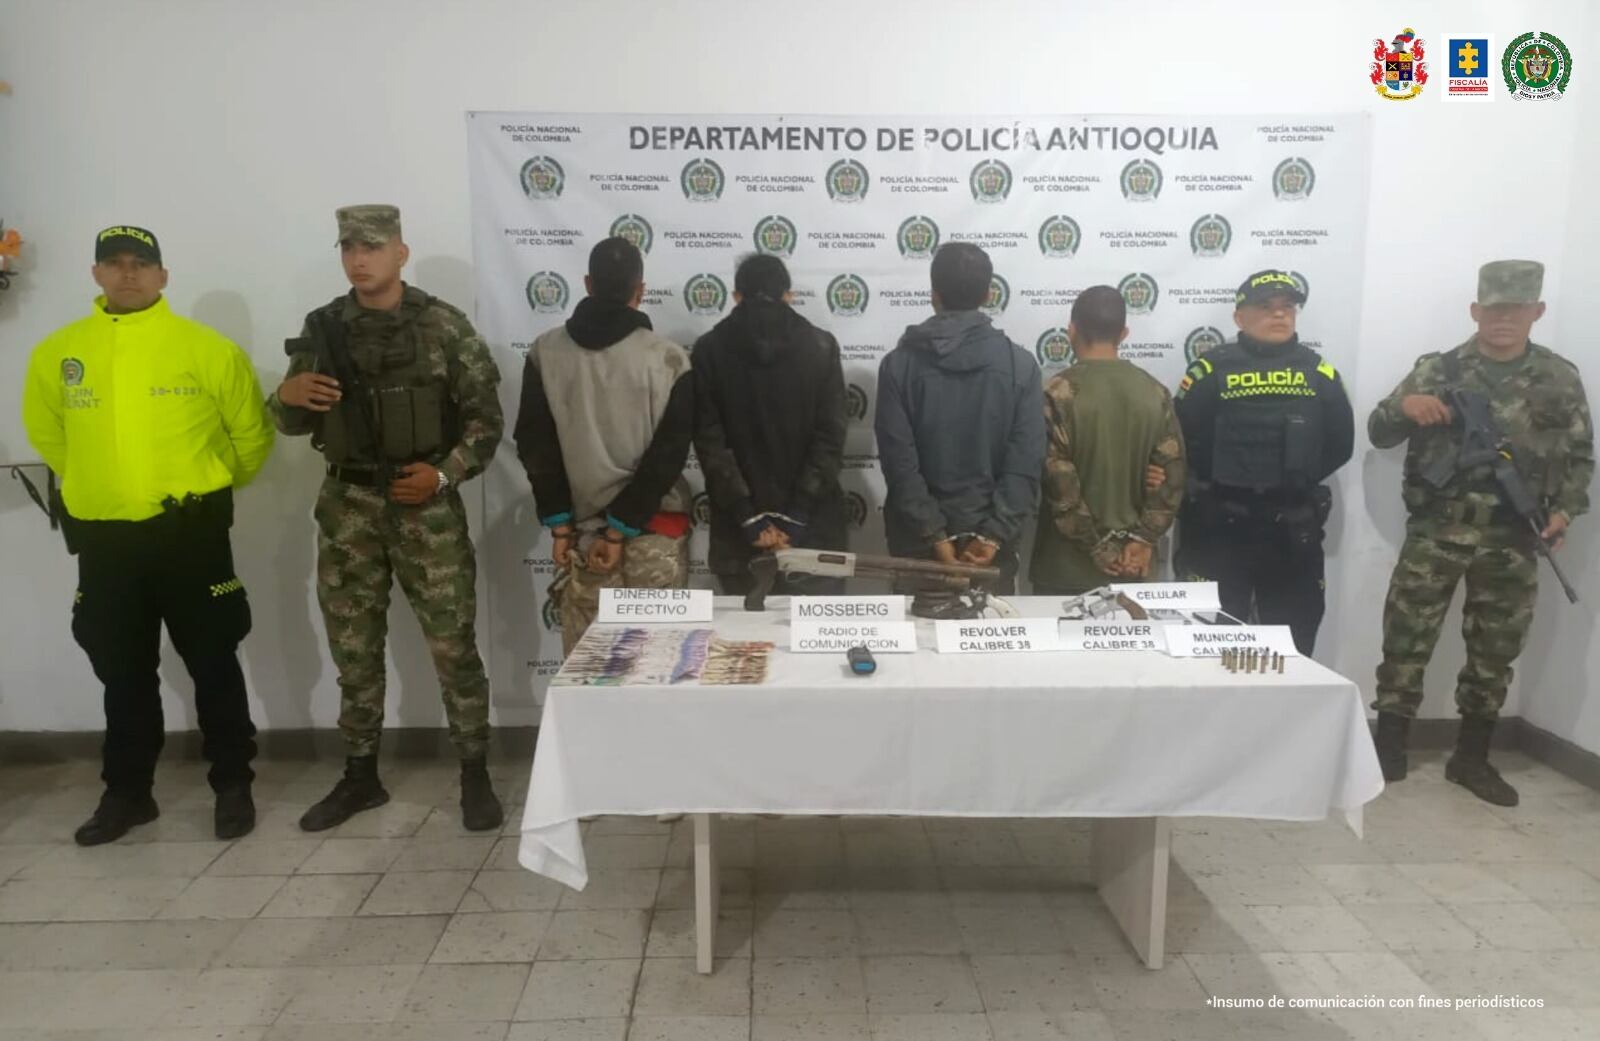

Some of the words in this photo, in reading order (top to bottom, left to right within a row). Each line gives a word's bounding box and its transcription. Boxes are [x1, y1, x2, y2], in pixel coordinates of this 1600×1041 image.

[537, 125, 581, 134] NACIONAL
[1291, 125, 1334, 133] NACIONAL
[525, 135, 572, 143] COLOMBIA
[629, 125, 867, 151] DEPARTAMENTO
[876, 128, 914, 151] DE
[924, 121, 1041, 151] POLICÍA
[1046, 126, 1219, 155] ANTIOQUIA
[625, 174, 670, 183] NACIONAL
[771, 175, 815, 184] NACIONAL
[915, 176, 959, 184] NACIONAL
[1210, 175, 1254, 183] NACIONAL
[601, 183, 612, 191] DE
[614, 184, 659, 192] COLOMBIA
[759, 185, 804, 193] COLOMBIA
[904, 185, 948, 193] COLOMBIA
[1033, 184, 1045, 192] DE
[1047, 184, 1090, 192] COLOMBIA
[1198, 184, 1242, 192] COLOMBIA
[699, 232, 743, 240] NACIONAL
[842, 232, 886, 240] NACIONAL
[985, 232, 1028, 240] NACIONAL
[1134, 231, 1178, 239] NACIONAL
[1286, 230, 1329, 238] NACIONAL
[529, 238, 573, 246] COLOMBIA
[688, 241, 732, 249] COLOMBIA
[818, 241, 829, 249] DE
[831, 241, 876, 249] COLOMBIA
[1110, 240, 1121, 248] DE
[1123, 240, 1168, 248] COLOMBIA
[1262, 238, 1273, 246] DE
[1275, 238, 1318, 246] COLOMBIA
[1131, 342, 1175, 350] NACIONAL
[1226, 367, 1308, 389] POLICÍA
[613, 589, 668, 600] DINERO
[672, 589, 691, 600] EN
[1136, 589, 1188, 601] CELULAR
[616, 604, 687, 616] EFECTIVO
[798, 602, 889, 617] MOSSBERG
[818, 626, 858, 637] RADIO
[861, 626, 878, 637] DE
[959, 626, 1027, 637] REVOLVER
[1084, 625, 1151, 637] REVOLVER
[959, 640, 1014, 651] CALIBRE
[1017, 640, 1031, 649] 38
[1082, 640, 1138, 650] CALIBRE
[1141, 640, 1156, 649] 38
